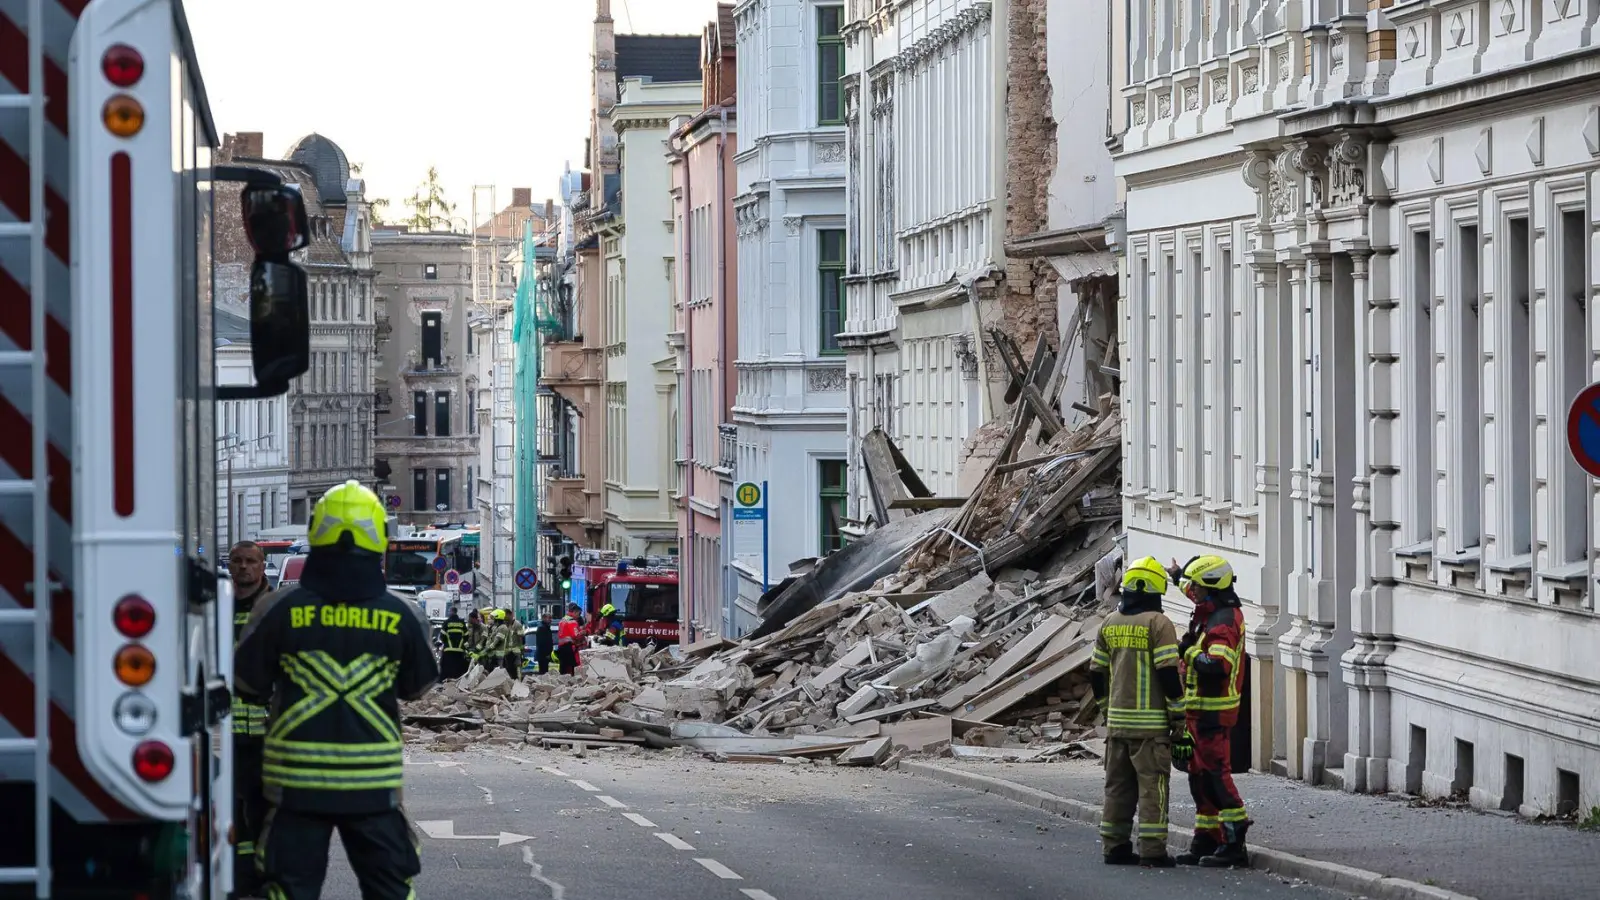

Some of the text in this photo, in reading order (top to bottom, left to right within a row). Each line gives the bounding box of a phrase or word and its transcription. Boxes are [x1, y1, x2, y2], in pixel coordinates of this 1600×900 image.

[743, 487, 754, 502] H
[290, 603, 402, 635] BF GÖRLITZ
[624, 627, 680, 636] FEUERWEHR
[1107, 636, 1149, 649] UERWEHR
